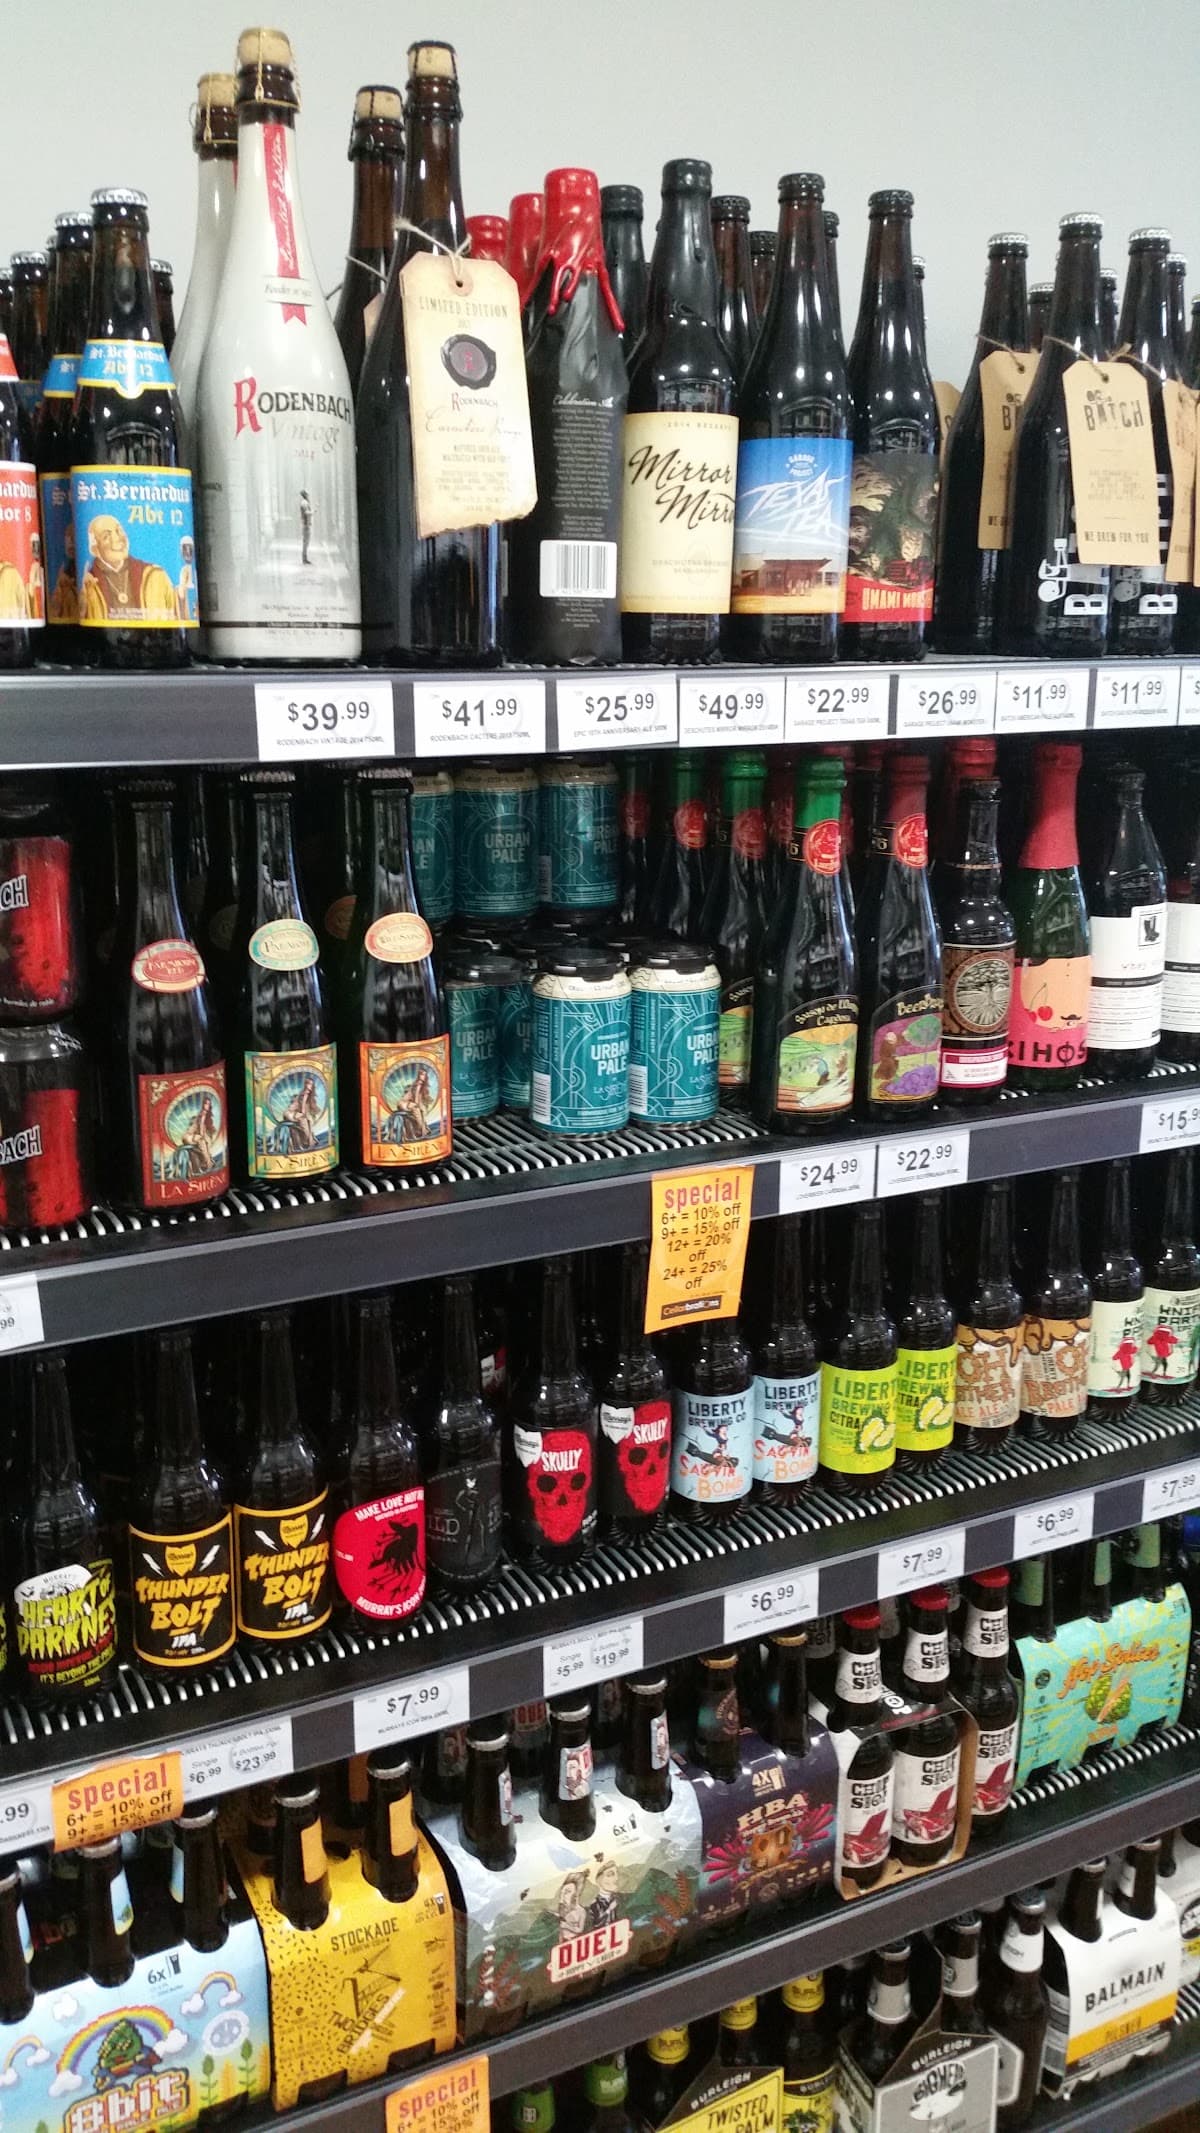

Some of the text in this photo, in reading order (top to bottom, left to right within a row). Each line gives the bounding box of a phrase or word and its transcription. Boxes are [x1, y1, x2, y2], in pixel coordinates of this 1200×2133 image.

[419, 296, 509, 319] LIMITED EDITION
[89, 345, 107, 360] St.
[233, 376, 352, 440] RODENBACH
[628, 445, 733, 489] Mirror
[76, 480, 191, 504] St. Bernardus
[24, 505, 32, 523] 8
[127, 504, 185, 526] Abt 12
[862, 587, 901, 611] UMAMI
[807, 687, 870, 713] $22.99
[918, 689, 977, 715] $26.99
[1012, 684, 1067, 709] $11.99
[1111, 680, 1162, 705] $11.99
[287, 700, 370, 731] $39.99
[442, 698, 518, 727] $41.99
[584, 692, 655, 722] $25.99
[698, 692, 764, 720] $49.99
[484, 831, 531, 849] URBAN
[491, 849, 525, 864] PALE
[463, 1046, 495, 1063] PALE
[597, 1058, 627, 1077] PALE
[1158, 1107, 1200, 1132] $15.9
[263, 1155, 289, 1172] LA
[377, 1143, 402, 1160] LA
[897, 1143, 953, 1172] $22.99
[800, 1158, 858, 1187] $24.99
[159, 1179, 184, 1200] LA
[664, 1175, 740, 1214] special
[661, 1202, 742, 1226] 6+ = 10% off
[661, 1217, 741, 1241] 9+ = 15% off
[667, 1232, 732, 1253] 12+ = 20%
[688, 1249, 707, 1263] off
[663, 1260, 728, 1281] 24+ = 25%
[685, 1277, 703, 1290] off
[764, 1378, 818, 1400] LIBERTY
[687, 1396, 746, 1417] LIBERTY
[632, 1417, 669, 1445] SKULLY
[687, 1414, 734, 1428] BREWING
[541, 1447, 583, 1473] SKULLY
[1160, 1474, 1197, 1498] $7.99
[354, 1496, 403, 1522] MAKE LOVE
[1036, 1507, 1075, 1532] $6.99
[903, 1546, 943, 1573] $7.99
[135, 1572, 230, 1605] THUNDER
[262, 1563, 327, 1606] BOLT
[22, 1577, 100, 1628] HEART
[356, 1595, 402, 1617] MURRAY'S
[751, 1584, 794, 1612] $6.99
[150, 1596, 223, 1638] BOLT
[284, 1601, 309, 1621] IPA
[171, 1632, 197, 1649] IPA
[556, 1660, 584, 1678] $5.99
[386, 1685, 440, 1717] $7.99
[235, 1750, 277, 1773] $23.99
[67, 1761, 168, 1813] special
[188, 1766, 222, 1785] $6.99
[66, 1790, 174, 1828] 6+ = 10% off
[736, 1793, 809, 1831] HBA
[67, 1827, 88, 1842] 9+
[111, 1813, 147, 1829] 15%
[150, 1803, 173, 1819] off
[330, 1917, 400, 1952] STOCKADE
[558, 1925, 624, 1970] DUEL
[147, 1968, 167, 1985] 6x
[1085, 1961, 1166, 2013] BALMAIN
[336, 1992, 391, 2054] BRIDGES
[911, 2038, 973, 2070] BURLEIGH
[399, 2067, 477, 2119] special
[690, 2071, 751, 2110] BURLEIGH
[431, 2100, 459, 2119] 10%
[461, 2089, 480, 2107] off
[461, 2102, 480, 2118] off
[707, 2092, 768, 2130] TWISTED
